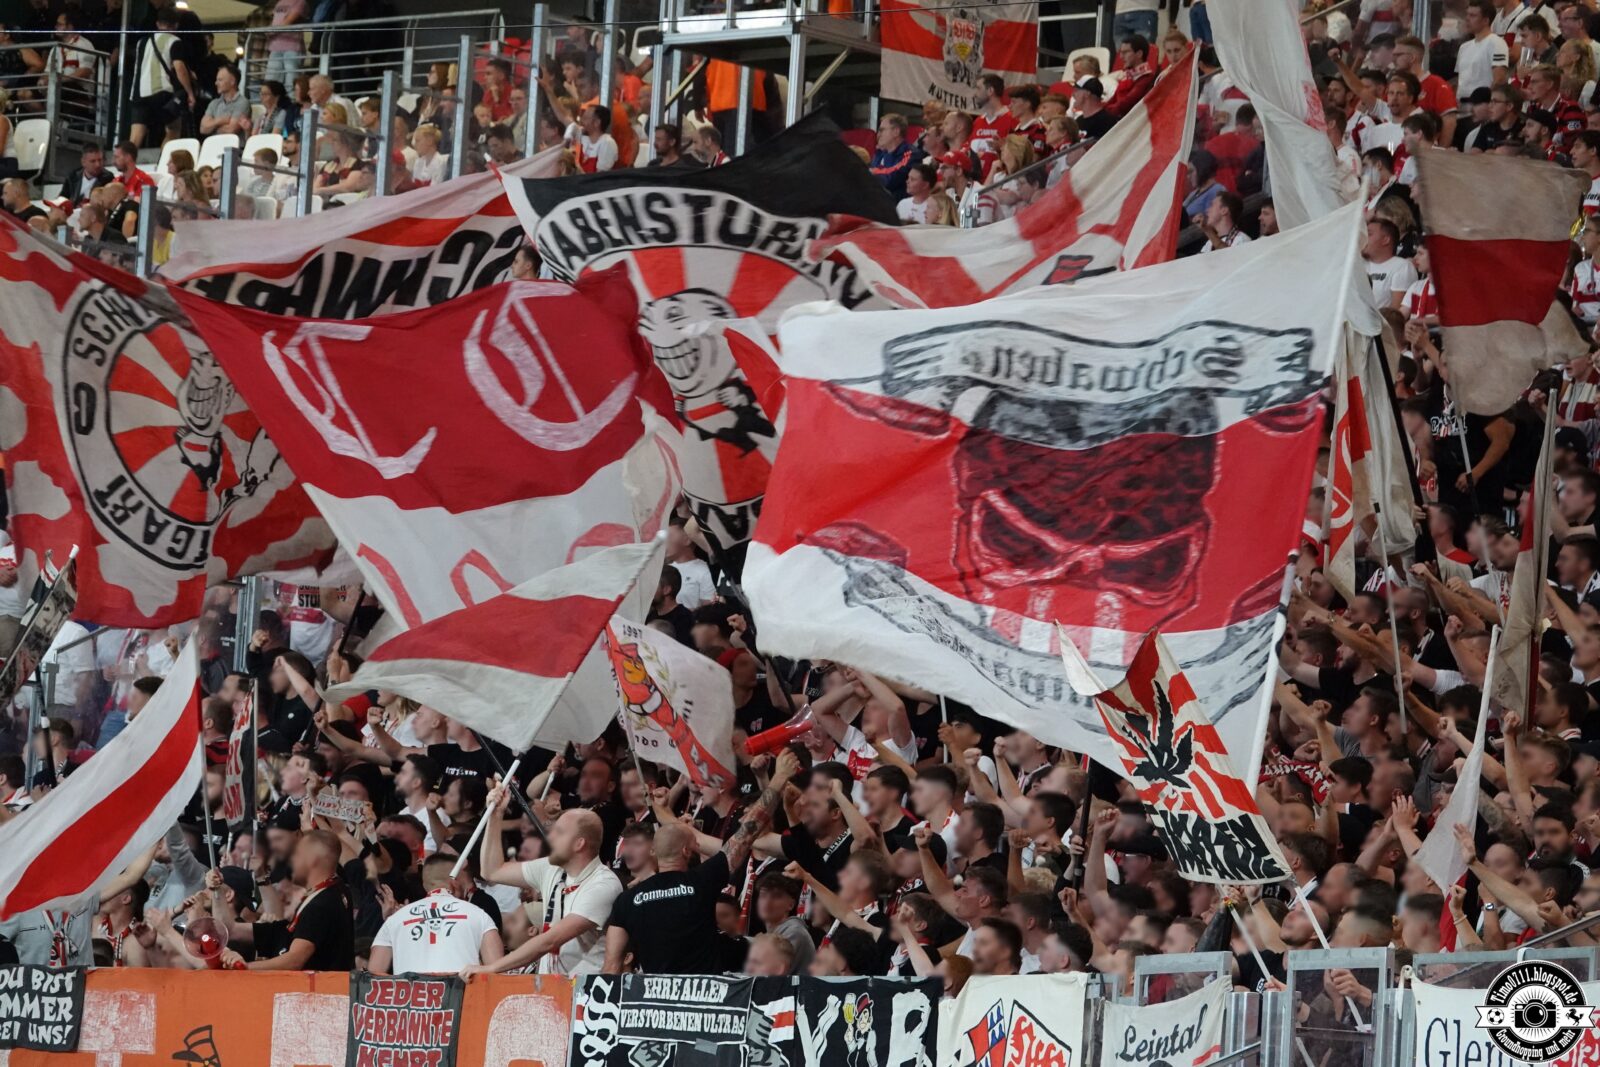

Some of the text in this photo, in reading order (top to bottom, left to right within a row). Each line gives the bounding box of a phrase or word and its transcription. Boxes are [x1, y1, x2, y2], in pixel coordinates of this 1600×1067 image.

[928, 82, 967, 109] KUTTEN
[633, 884, 695, 906] Commando
[31, 968, 77, 994] BIST
[365, 979, 445, 1009] JEDER
[643, 977, 729, 1003] EHRE ALLEN
[0, 992, 73, 1023] MMER
[27, 1022, 74, 1045] UNS!
[352, 1003, 454, 1047] VERBANNTE
[620, 1008, 746, 1035] VERSTORBENEN ULTRAS
[1115, 1003, 1208, 1062] Leintal
